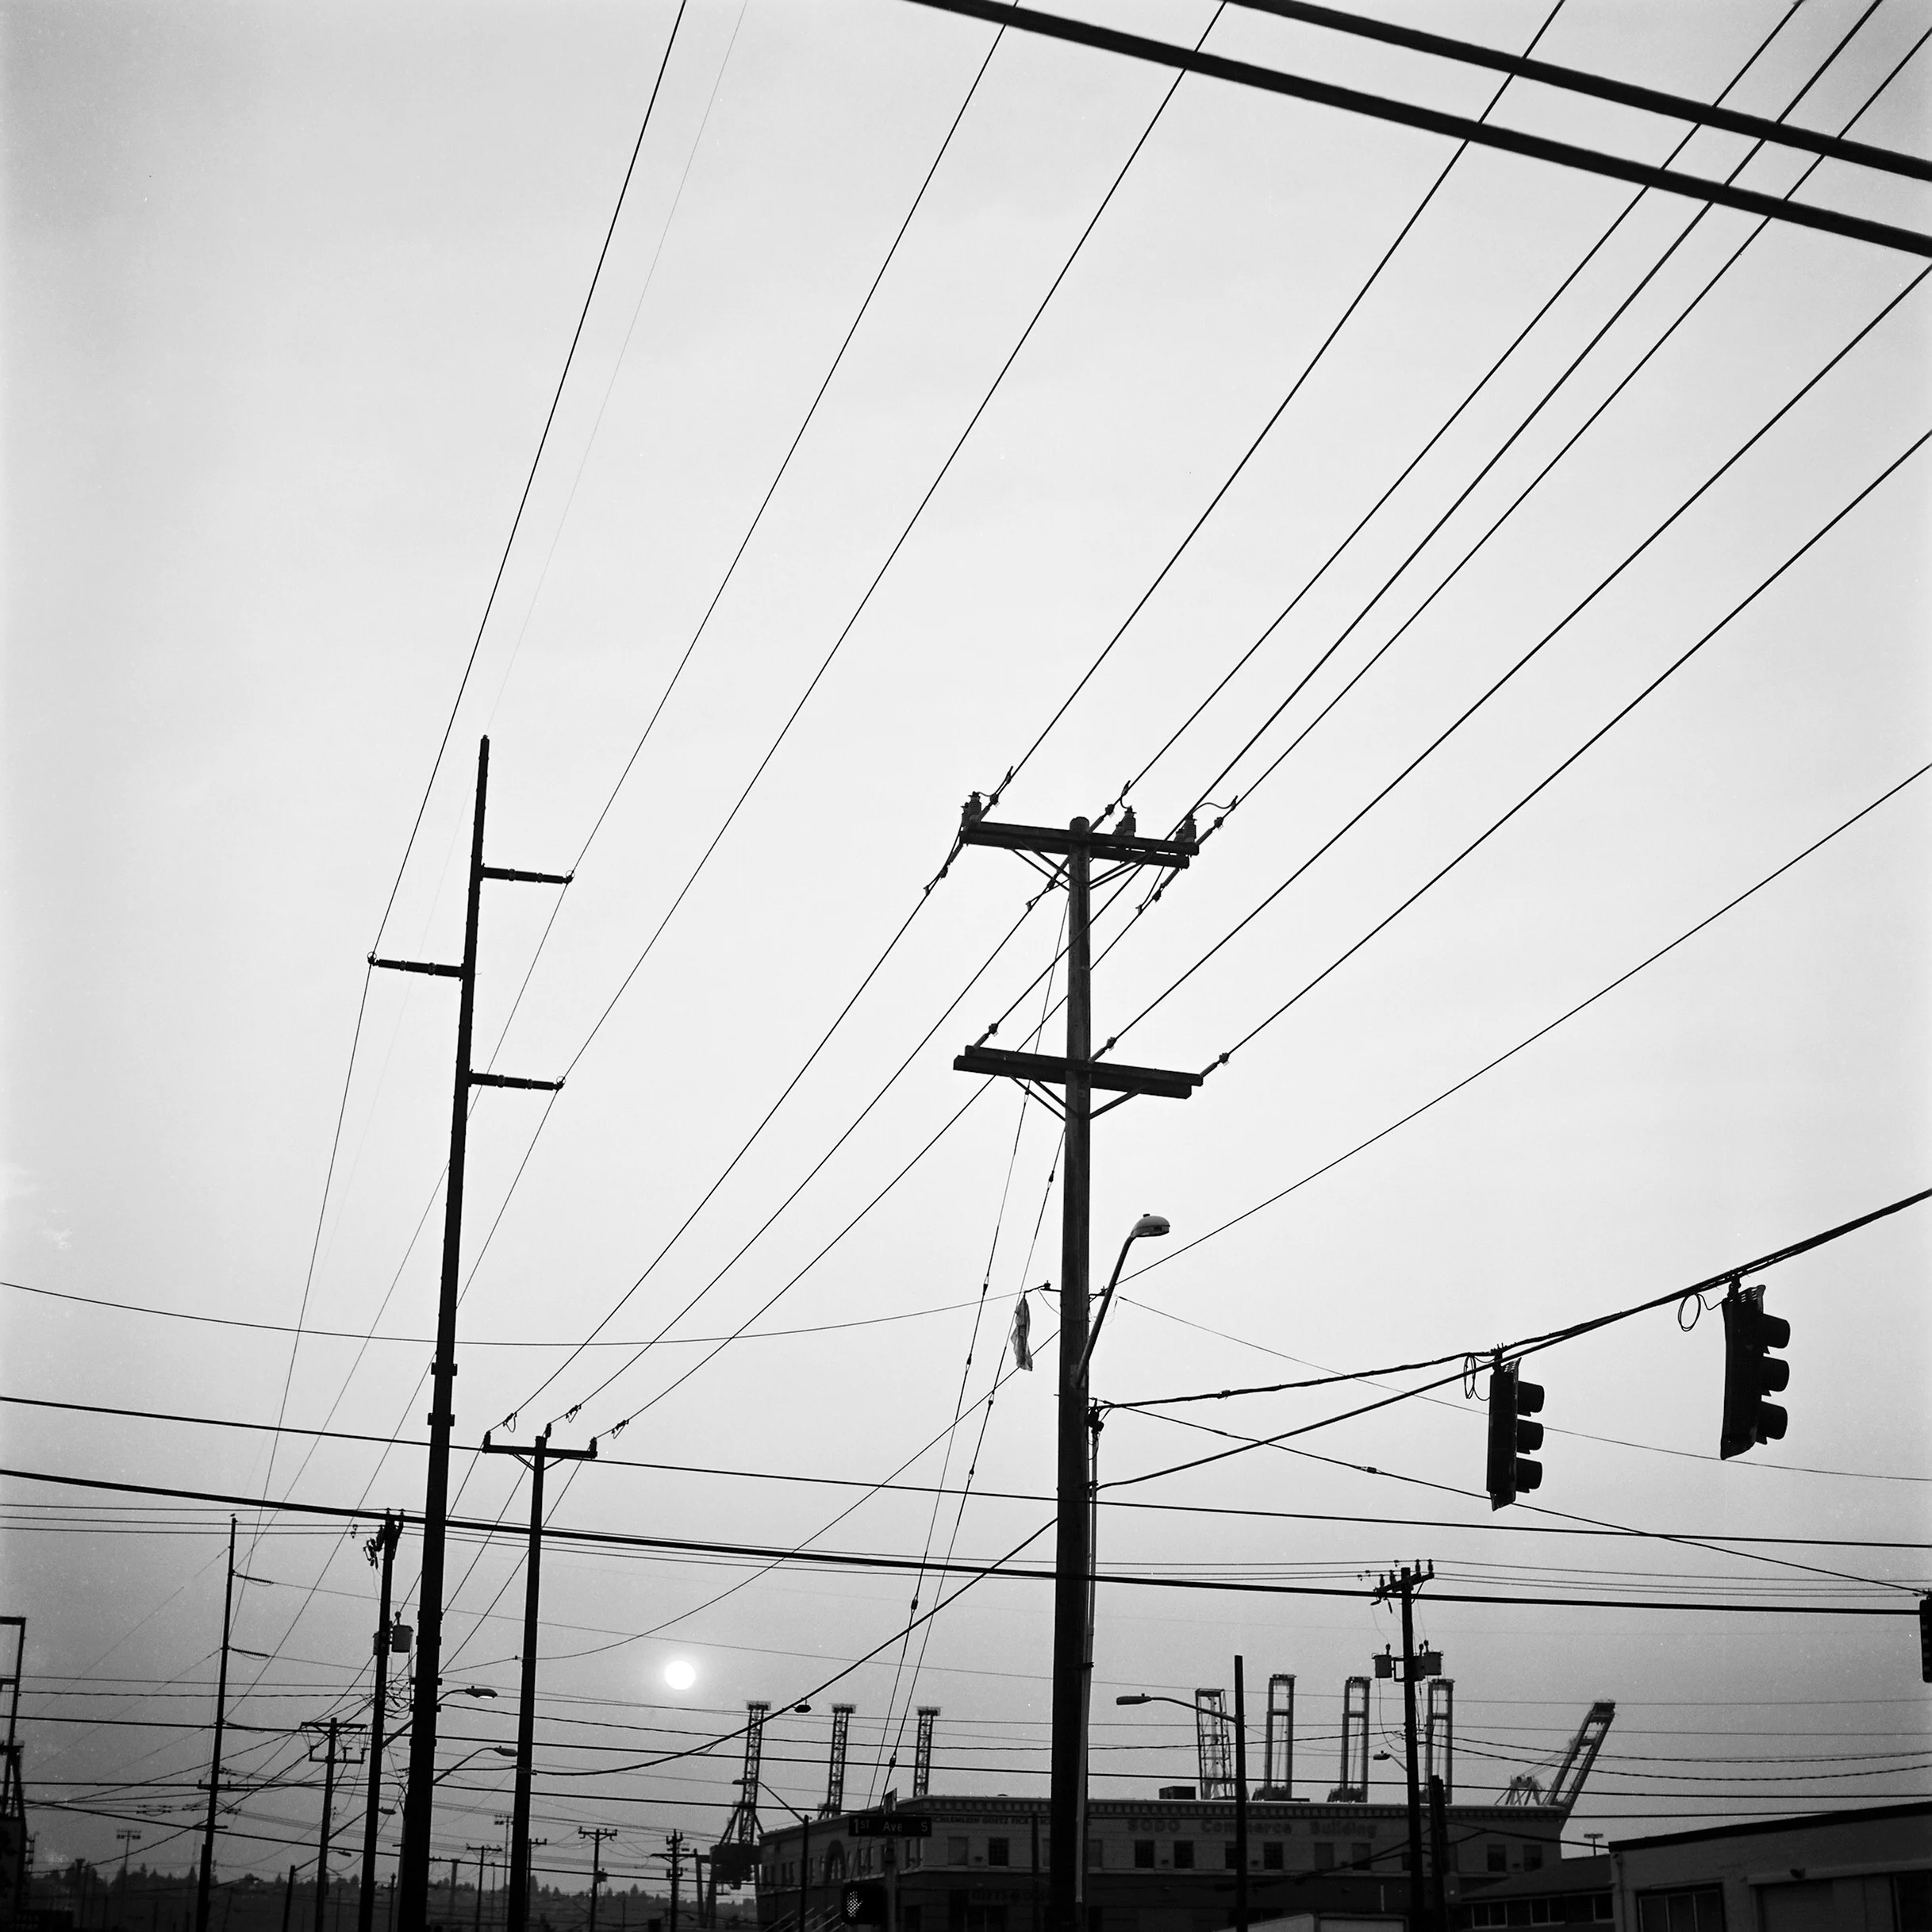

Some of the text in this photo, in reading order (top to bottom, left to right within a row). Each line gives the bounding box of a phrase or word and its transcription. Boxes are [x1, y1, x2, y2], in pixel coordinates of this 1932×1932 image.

[854, 1819, 928, 1834] 1st Ave S
[1127, 1819, 1180, 1832] SODO
[1310, 1820, 1377, 1838] Building
